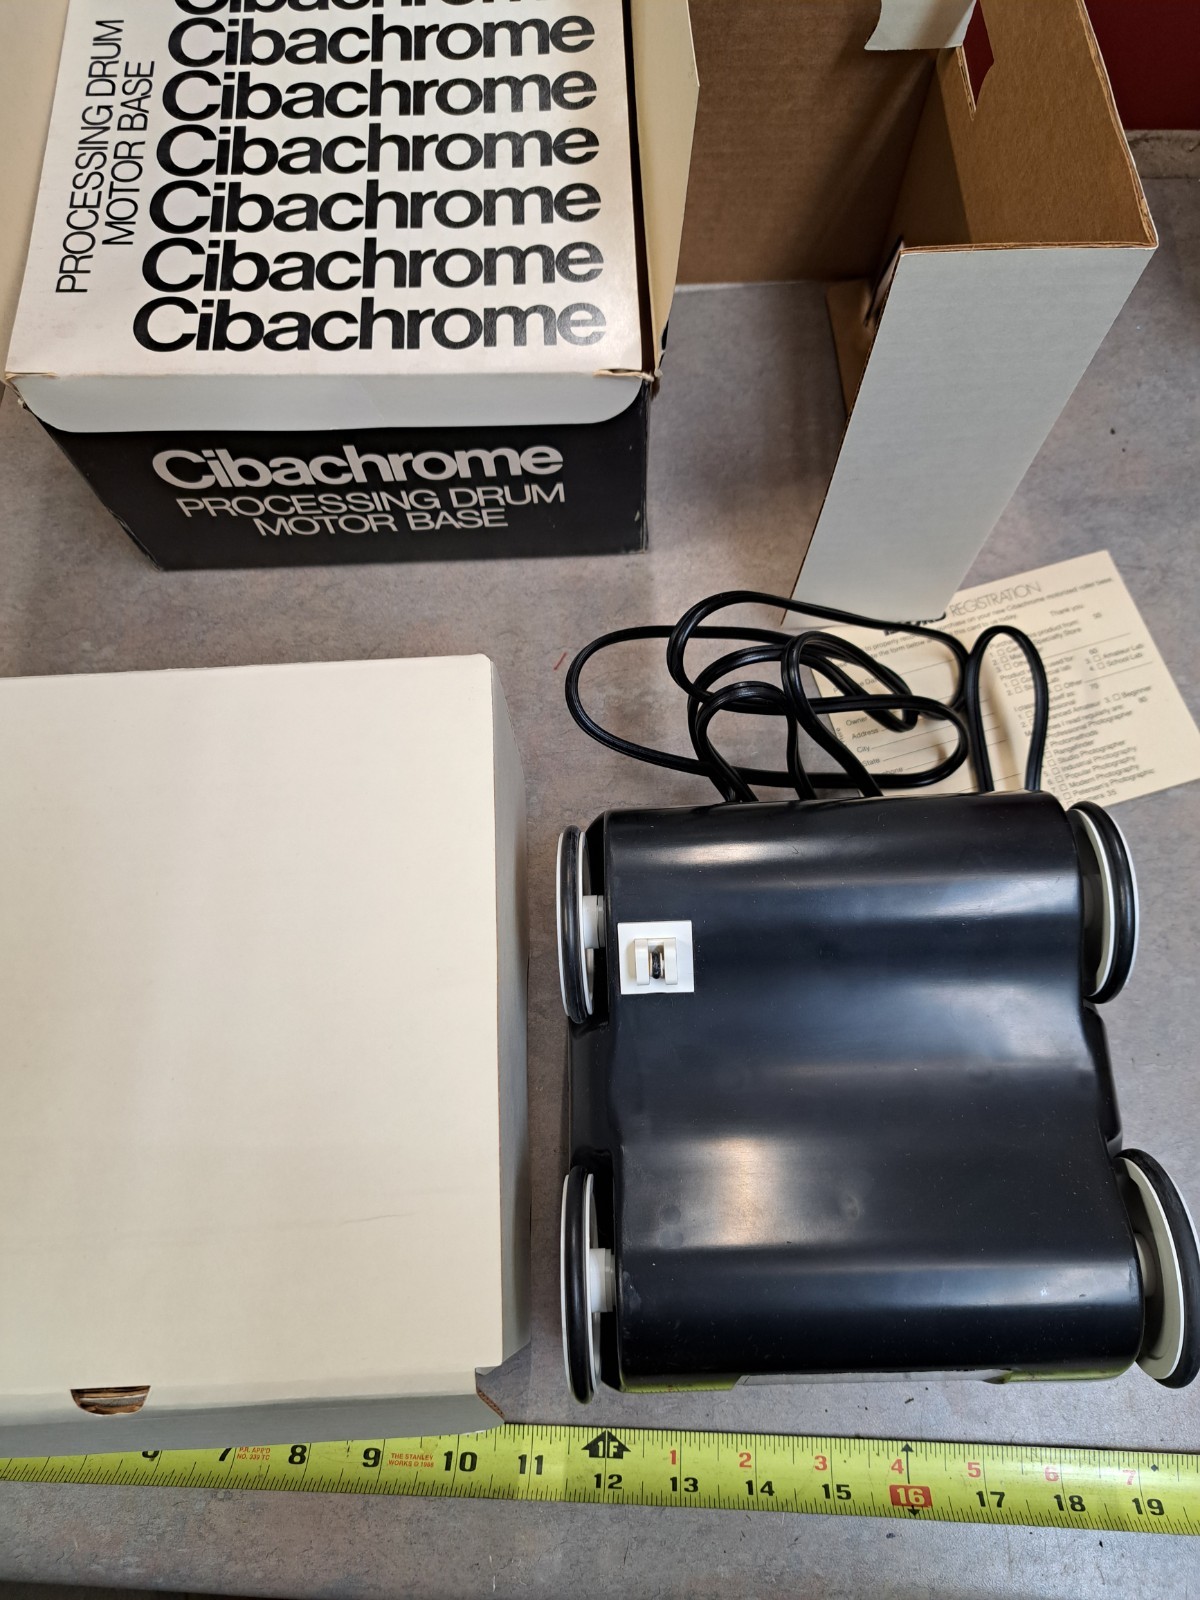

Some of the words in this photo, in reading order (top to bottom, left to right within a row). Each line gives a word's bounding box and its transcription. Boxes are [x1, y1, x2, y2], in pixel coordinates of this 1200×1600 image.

[168, 13, 594, 68] Cibachrome
[117, 61, 155, 131] BASE
[163, 69, 597, 121] Cibachrome
[55, 105, 114, 293] PROCESSING
[85, 19, 124, 97] DRUM
[157, 123, 599, 177] Cibachrome
[101, 141, 146, 245] MOTOR
[150, 179, 602, 235] Cibachrome
[142, 237, 603, 293] Cibachrome
[133, 297, 607, 352] Cibachrome
[152, 444, 564, 490] Cibachrome
[176, 489, 442, 517] PROCESSING
[448, 482, 566, 509] DRUM
[252, 513, 398, 536] MOTOR
[406, 509, 508, 531] BASE
[948, 580, 1042, 617] REGISTRATION
[846, 717, 869, 726] Owner
[852, 727, 879, 739] Address
[1058, 754, 1080, 764] Studio
[1079, 740, 1125, 757] Photographer
[1093, 746, 1137, 762] Photography
[863, 758, 881, 766] State
[1092, 756, 1136, 771] Photography
[1095, 764, 1139, 780] Photography
[288, 1444, 308, 1465] 8
[362, 1447, 382, 1468] 9
[391, 1452, 404, 1460] THE
[405, 1453, 434, 1461] STANLEY
[597, 1440, 619, 1457] 1F
[669, 1449, 677, 1465] 1
[388, 1459, 412, 1467] WORKS
[444, 1450, 478, 1472] 10
[518, 1454, 544, 1475] 11
[738, 1452, 752, 1468] 2
[814, 1455, 828, 1471] 3
[891, 1458, 904, 1474] 4
[967, 1461, 981, 1478] 5
[1044, 1466, 1059, 1482] 6
[1122, 1469, 1137, 1486] 7
[594, 1473, 623, 1490] 12
[669, 1476, 699, 1492] 13
[745, 1479, 775, 1497] 14
[821, 1483, 852, 1500] 15
[896, 1487, 925, 1505] 16
[975, 1490, 1006, 1508] 17
[1053, 1494, 1086, 1512] 18
[1131, 1497, 1165, 1516] 19
